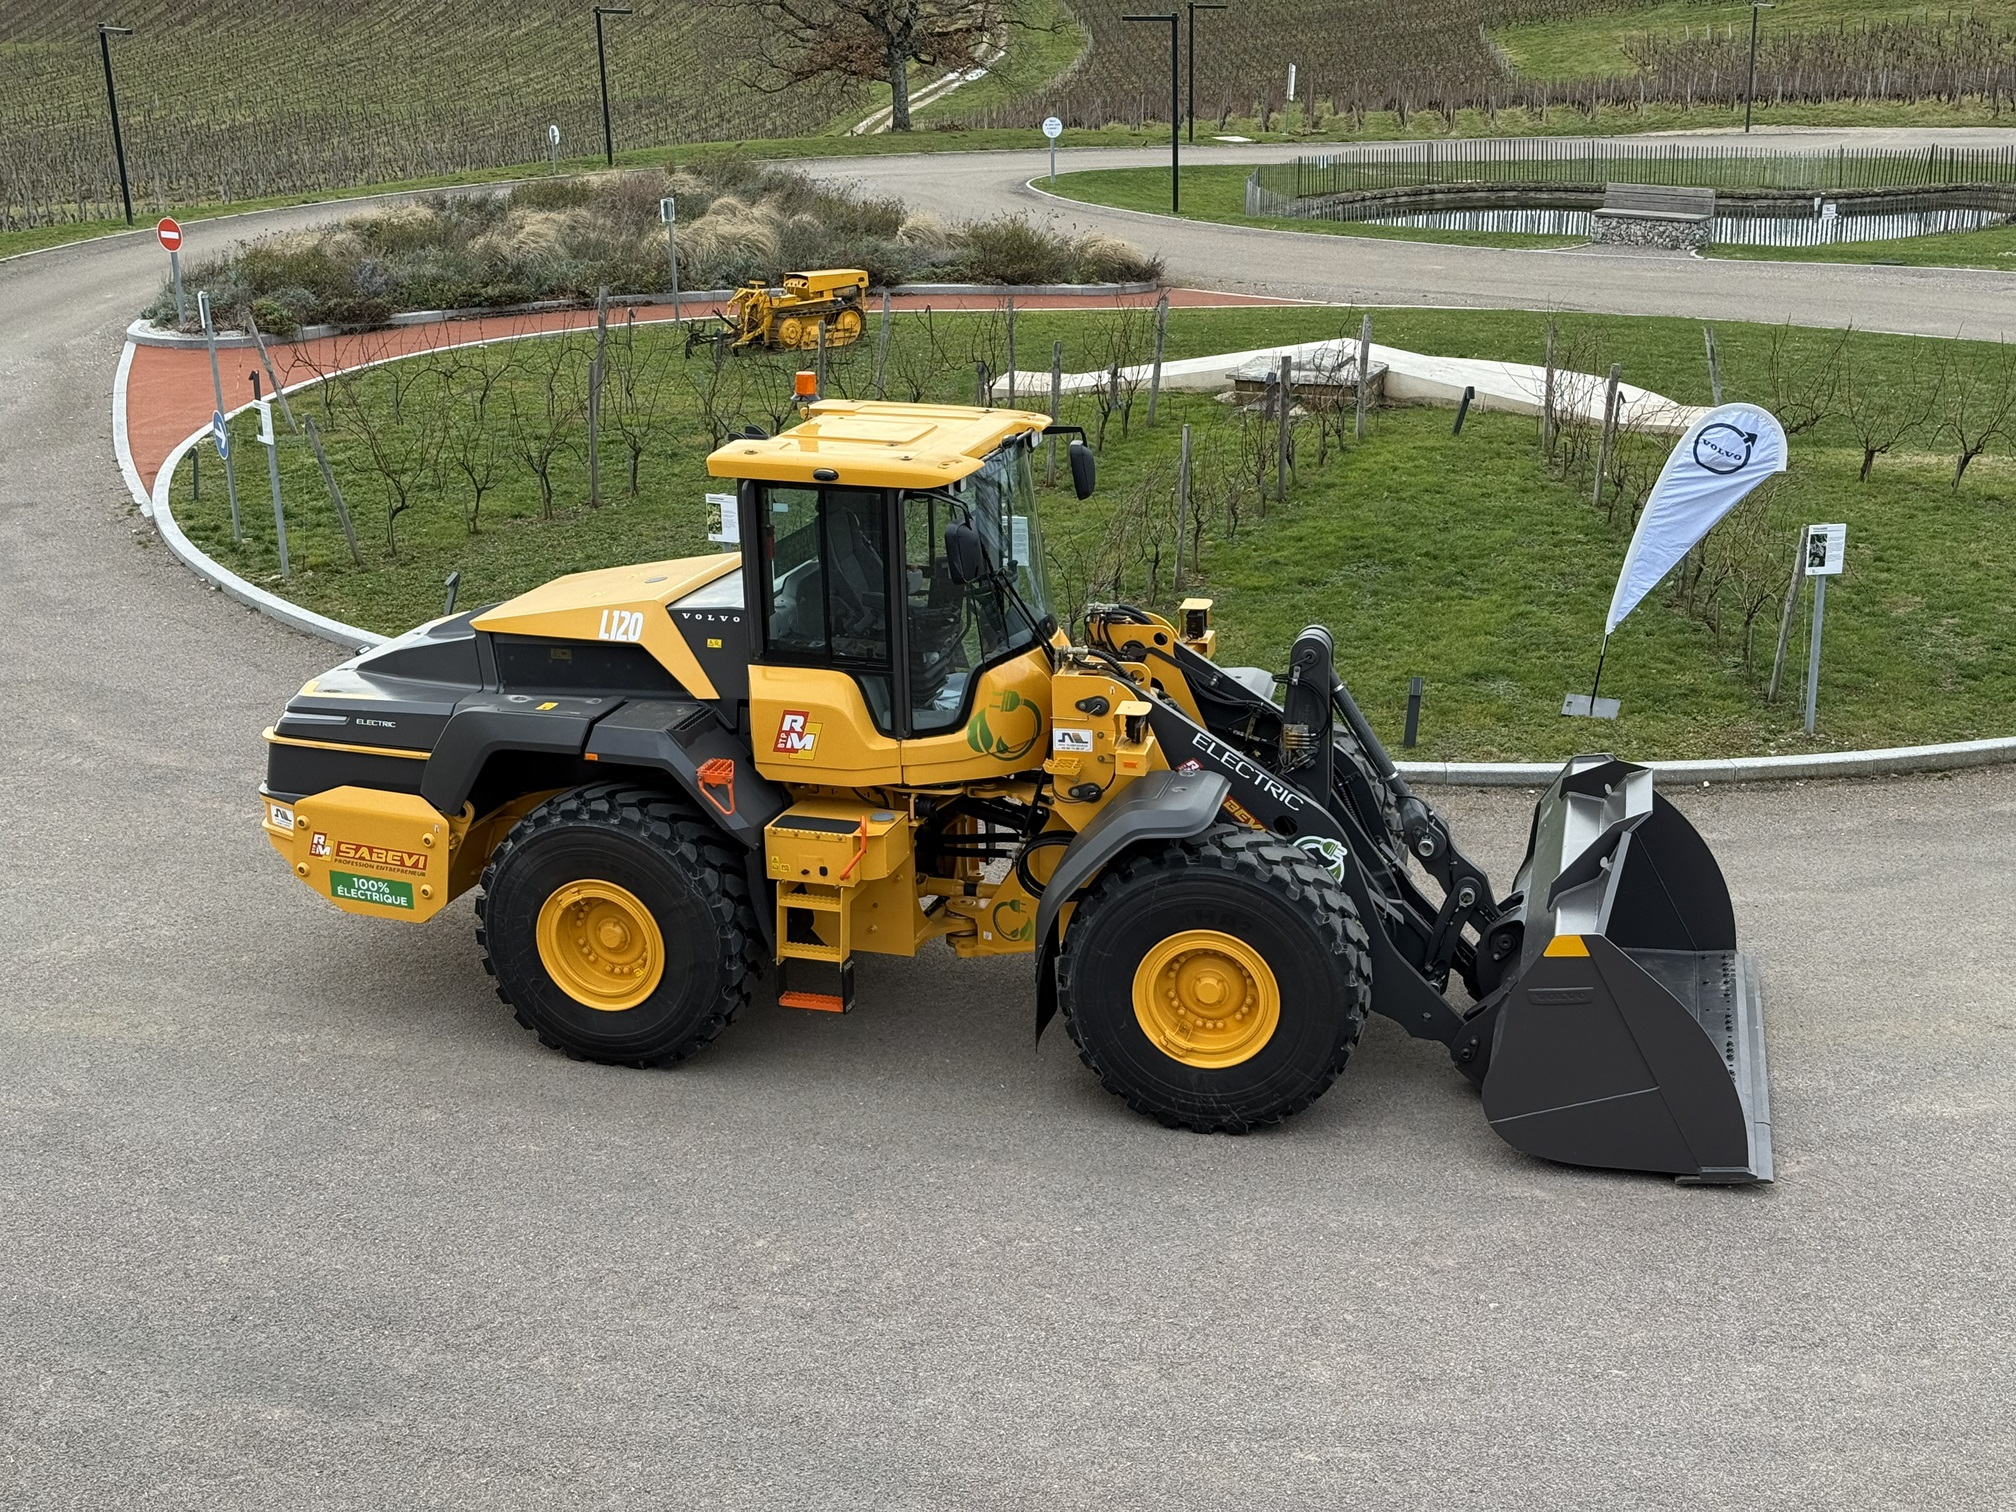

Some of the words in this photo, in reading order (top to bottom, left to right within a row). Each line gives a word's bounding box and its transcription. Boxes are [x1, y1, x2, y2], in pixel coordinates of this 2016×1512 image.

[1701, 438, 1742, 461] VOLVO
[598, 609, 644, 642] L120
[681, 612, 741, 623] VOLVO
[356, 718, 396, 728] ELECTRIC
[1192, 732, 1304, 811] ELECTRIC
[338, 843, 426, 869] SABEVI
[334, 858, 375, 870] PROFESSION
[375, 865, 427, 877] ENTREPRENEUR
[337, 884, 409, 906] ÉLECTRIQUE
[352, 877, 390, 894] 100%
